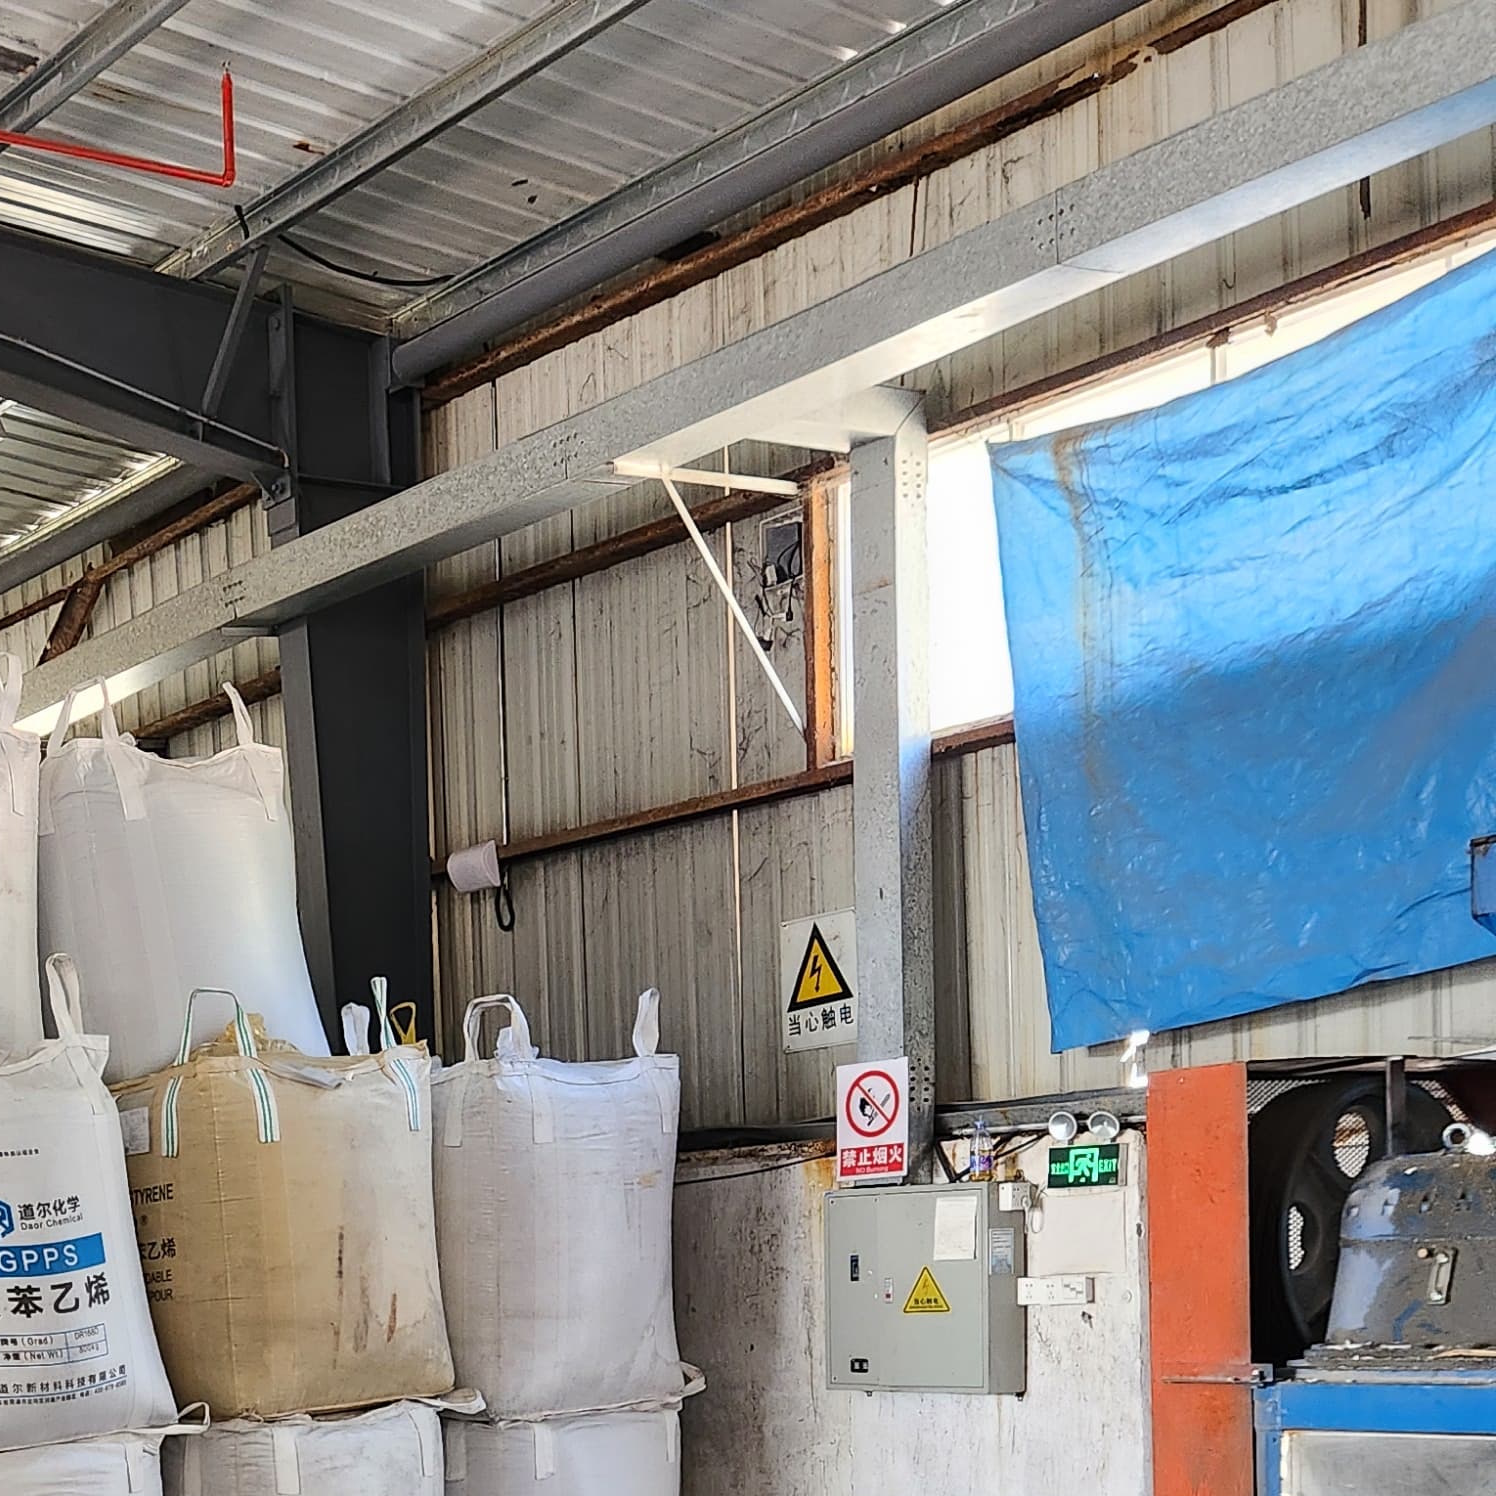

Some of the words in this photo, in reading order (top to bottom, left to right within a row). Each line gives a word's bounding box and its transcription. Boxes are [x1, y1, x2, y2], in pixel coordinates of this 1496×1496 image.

[788, 1002, 854, 1036] 当心触电
[842, 1145, 903, 1169] 禁止烟火
[1099, 1158, 1118, 1173] EXIT
[18, 1195, 81, 1221] 道尔化学
[45, 1212, 84, 1228] Chemical
